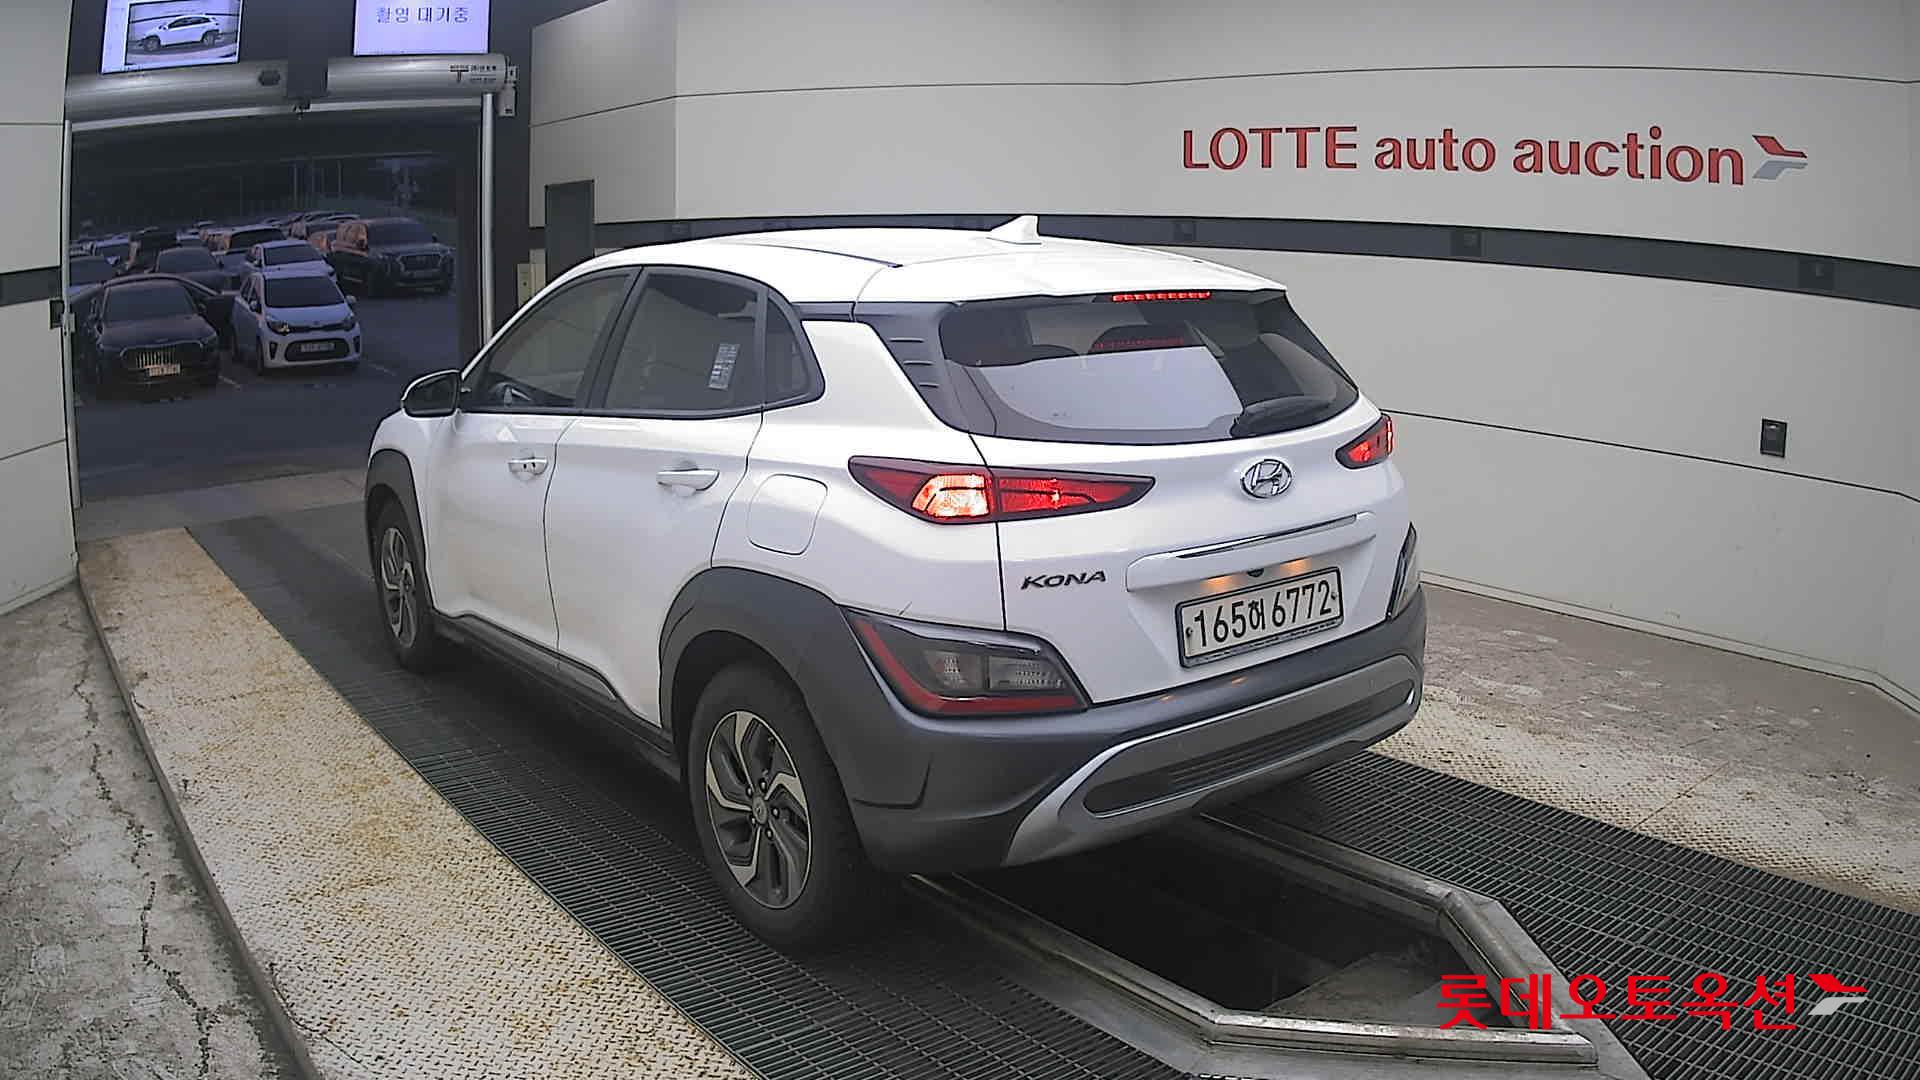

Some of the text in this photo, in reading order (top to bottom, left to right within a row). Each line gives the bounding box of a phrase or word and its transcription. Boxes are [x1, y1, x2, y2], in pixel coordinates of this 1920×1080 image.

[418, 7, 468, 23] 대기중
[1182, 126, 1745, 186] LOTTE auto auction
[1020, 570, 1107, 591] KONA
